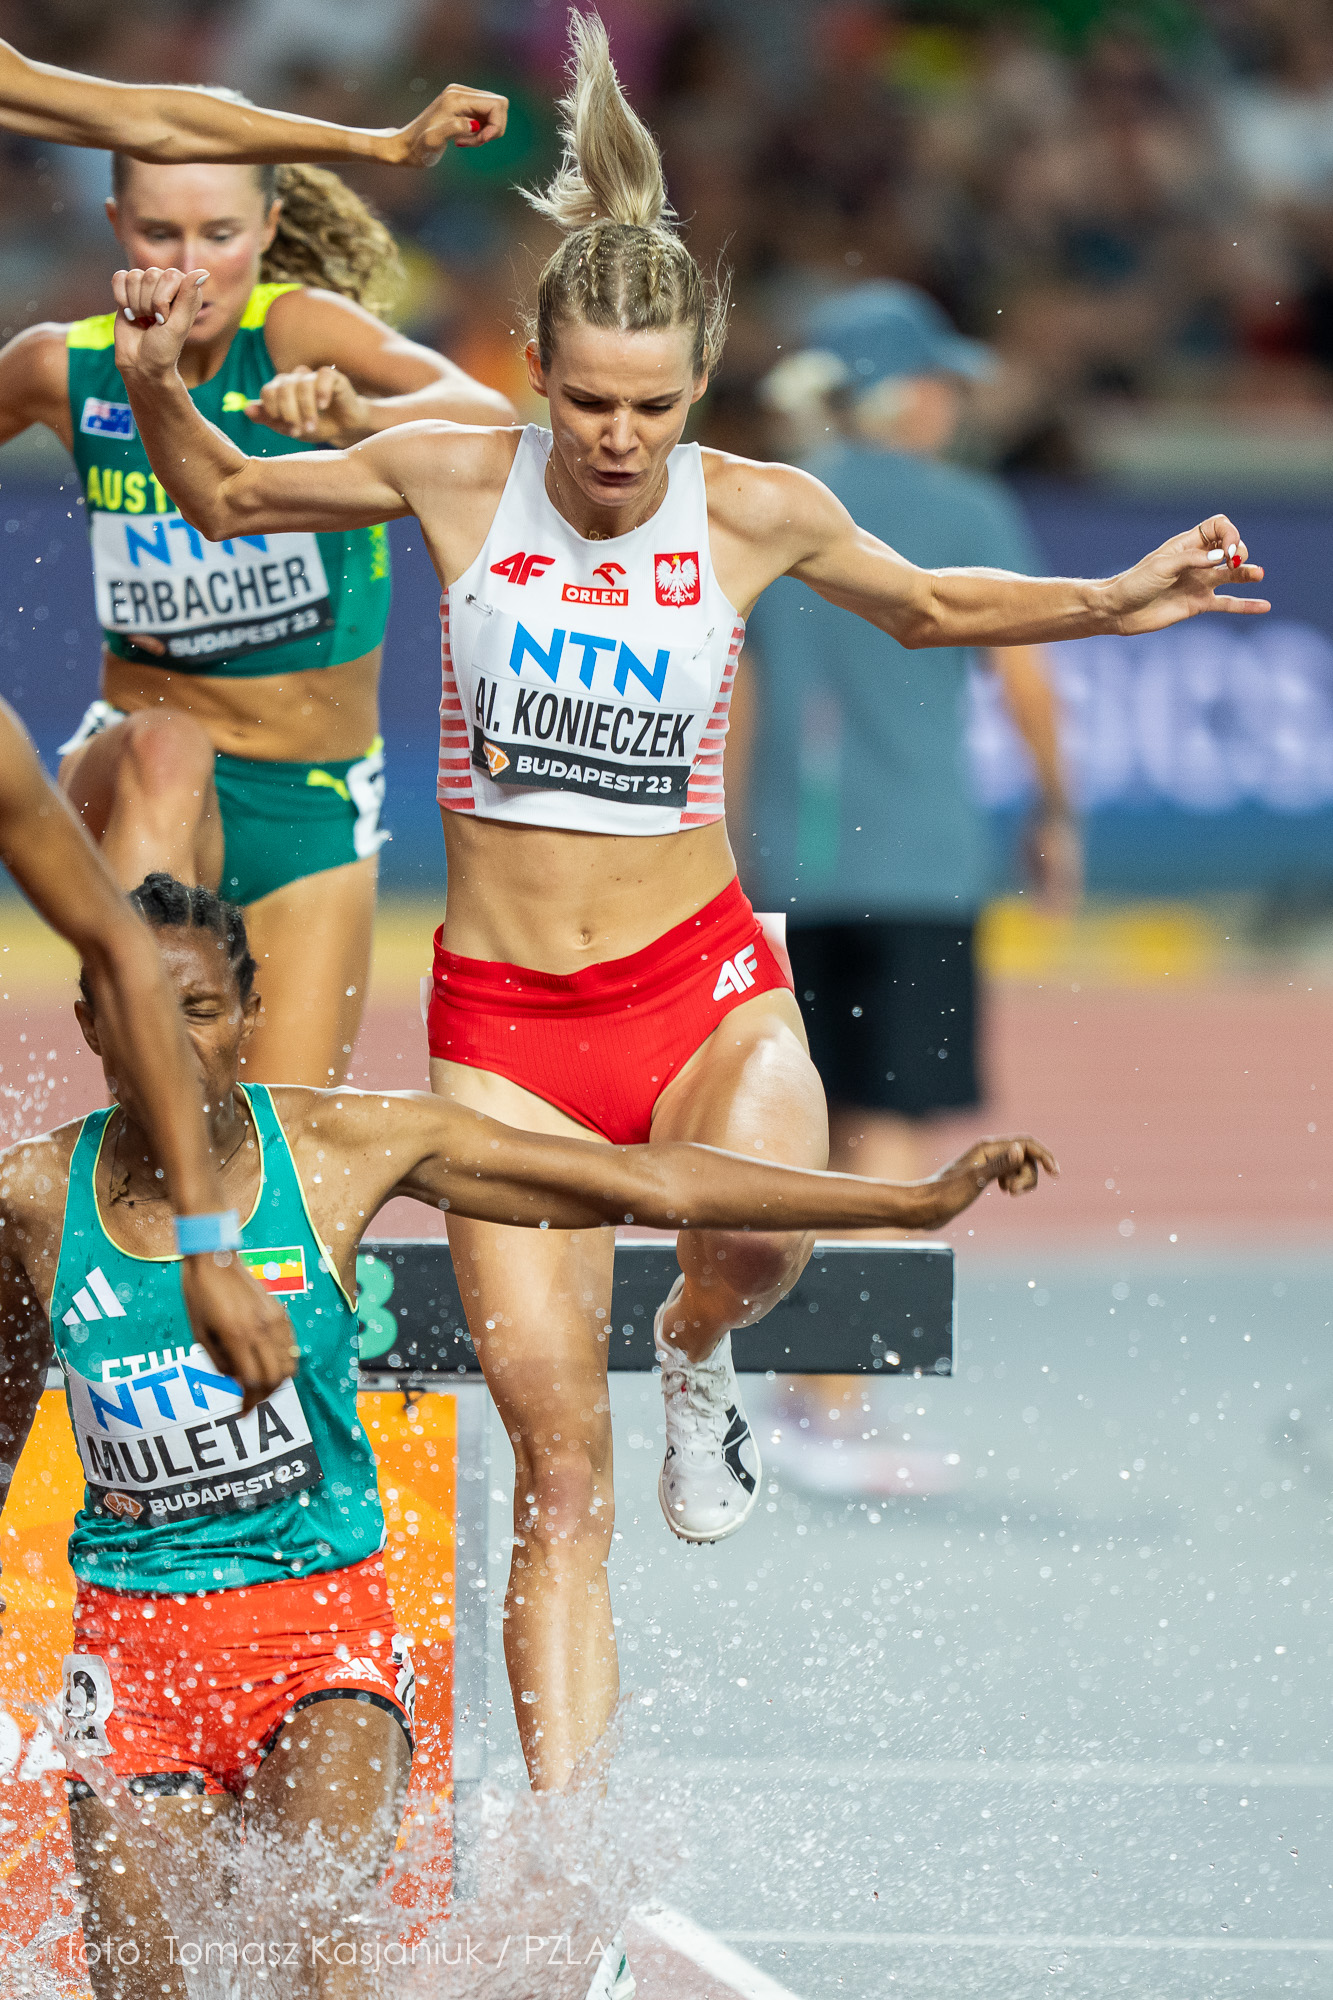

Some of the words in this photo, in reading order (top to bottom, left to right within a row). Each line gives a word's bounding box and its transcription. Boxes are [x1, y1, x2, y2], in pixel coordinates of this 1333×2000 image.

[87, 465, 182, 513] AUST
[109, 556, 312, 624] ERBACHER
[490, 551, 556, 586] 4F
[566, 587, 624, 604] ORLEN
[167, 622, 291, 658] BUDAPEST
[289, 609, 320, 637] 23
[509, 620, 670, 703] NTN
[512, 688, 694, 757] KONIECZEK
[516, 755, 645, 793] BUDAPEST
[646, 776, 672, 794] 23
[713, 943, 758, 1002] 4F
[86, 1401, 295, 1484] MULETA
[149, 1470, 275, 1515] BUDAPEST
[273, 1459, 307, 1484] 23
